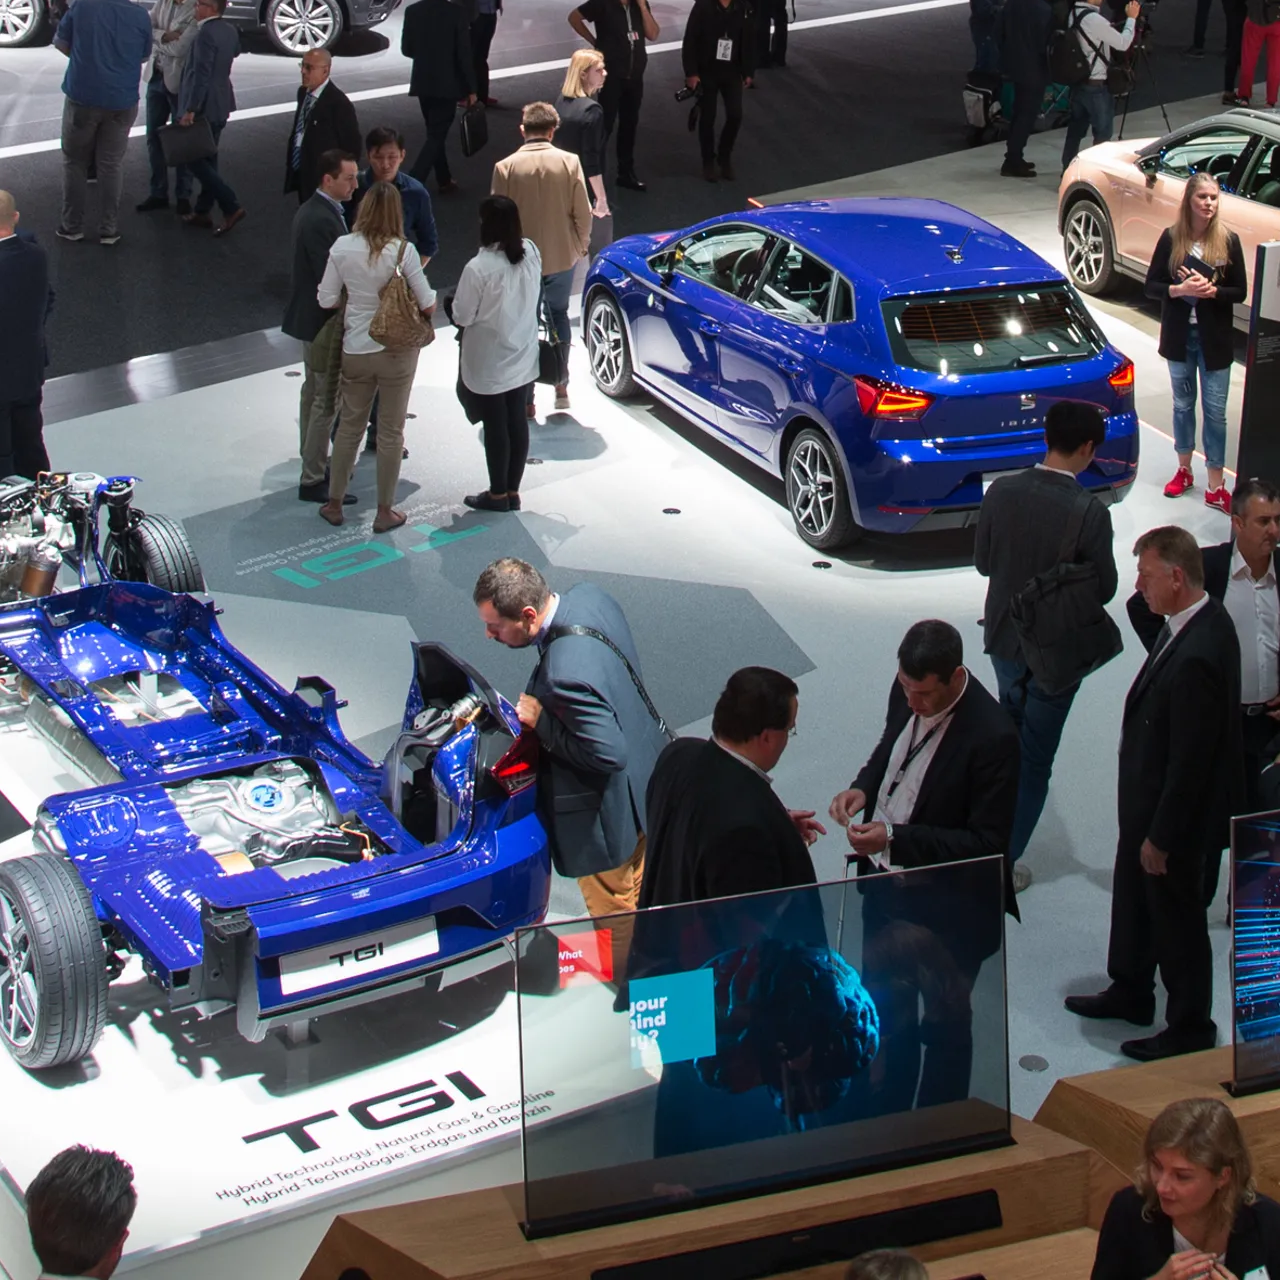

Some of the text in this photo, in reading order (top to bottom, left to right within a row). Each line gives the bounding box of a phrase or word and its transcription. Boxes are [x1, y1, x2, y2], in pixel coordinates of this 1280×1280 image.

[329, 942, 384, 967] TGI
[558, 949, 584, 961] What
[215, 1088, 557, 1202] Hybrid Technology: Natural Gas & Gasoline
[241, 1070, 487, 1155] TGI
[242, 1102, 553, 1208] Hybrid-Technologie: Erdgas und Benzin
